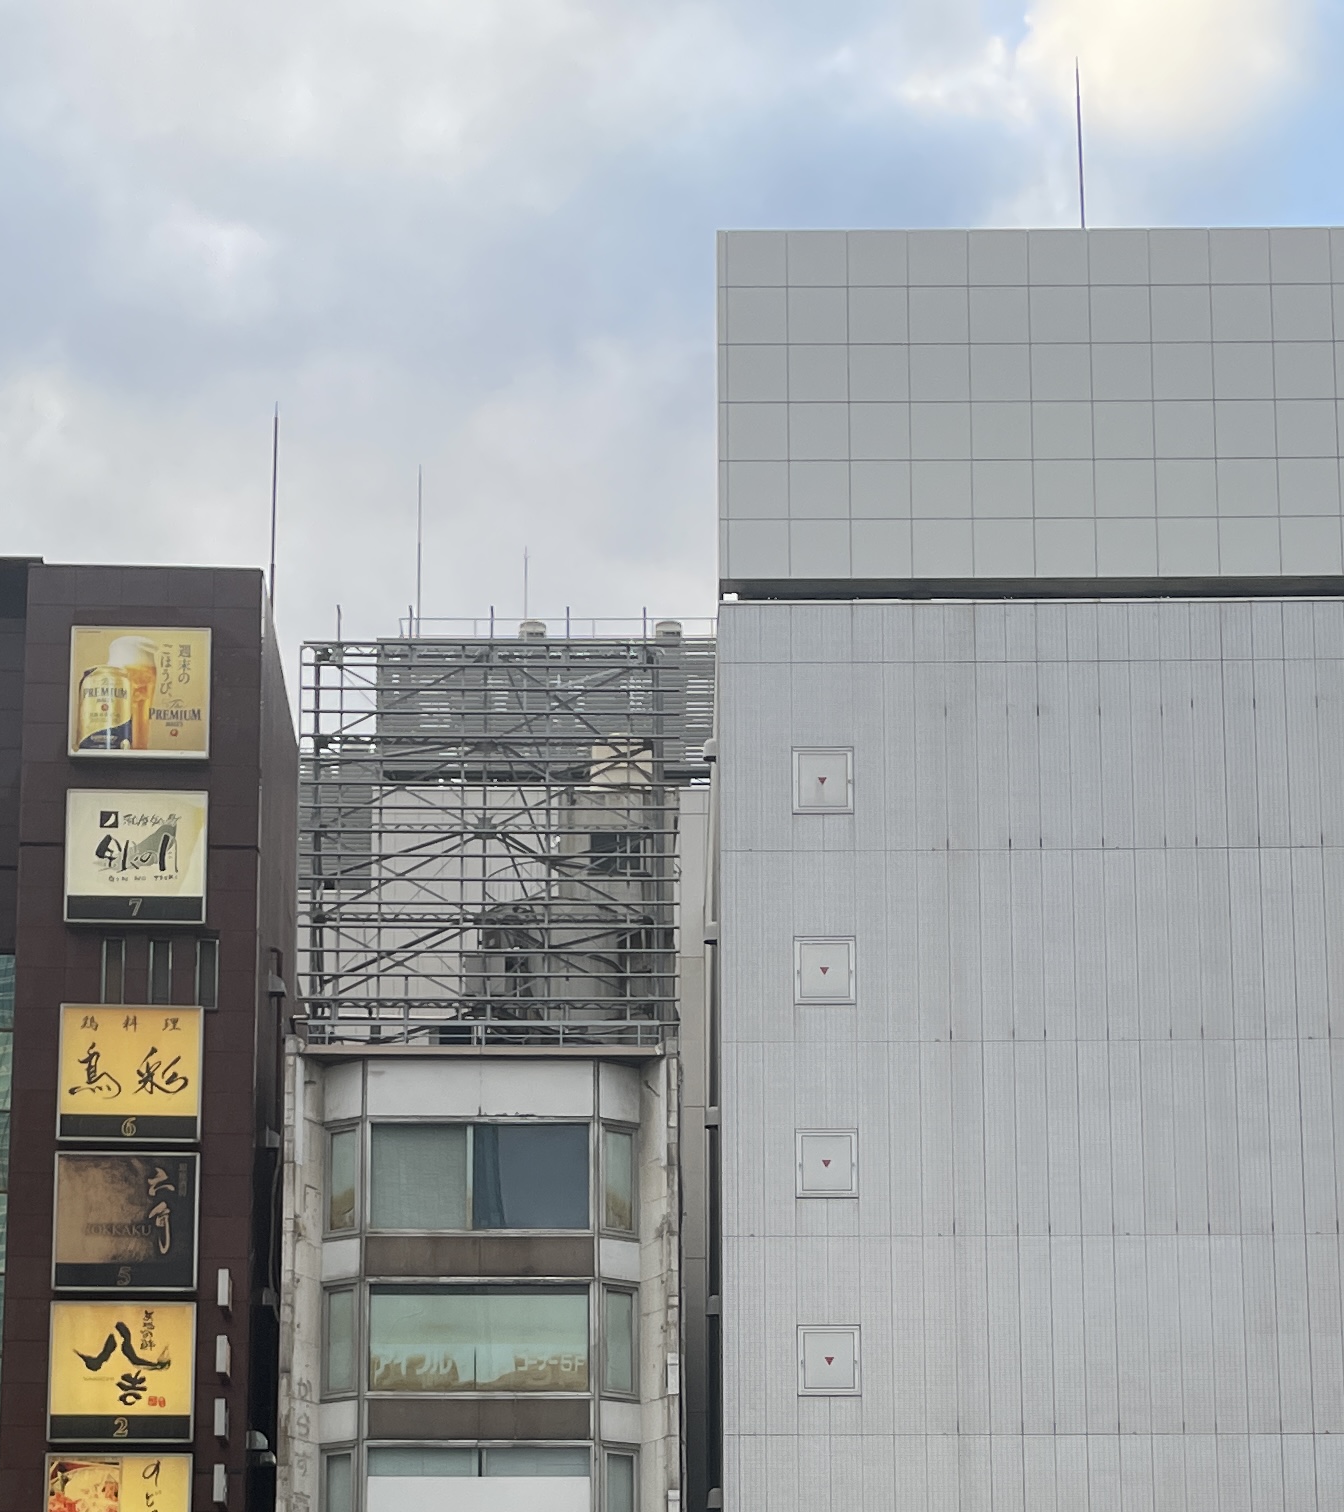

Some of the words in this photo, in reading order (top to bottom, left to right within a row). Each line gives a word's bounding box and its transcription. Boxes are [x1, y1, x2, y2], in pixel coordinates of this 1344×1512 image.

[178, 644, 191, 684] 週末の
[83, 686, 128, 699] PREMIUM
[149, 707, 201, 721] PREMIUM
[112, 1416, 129, 1438] 2
